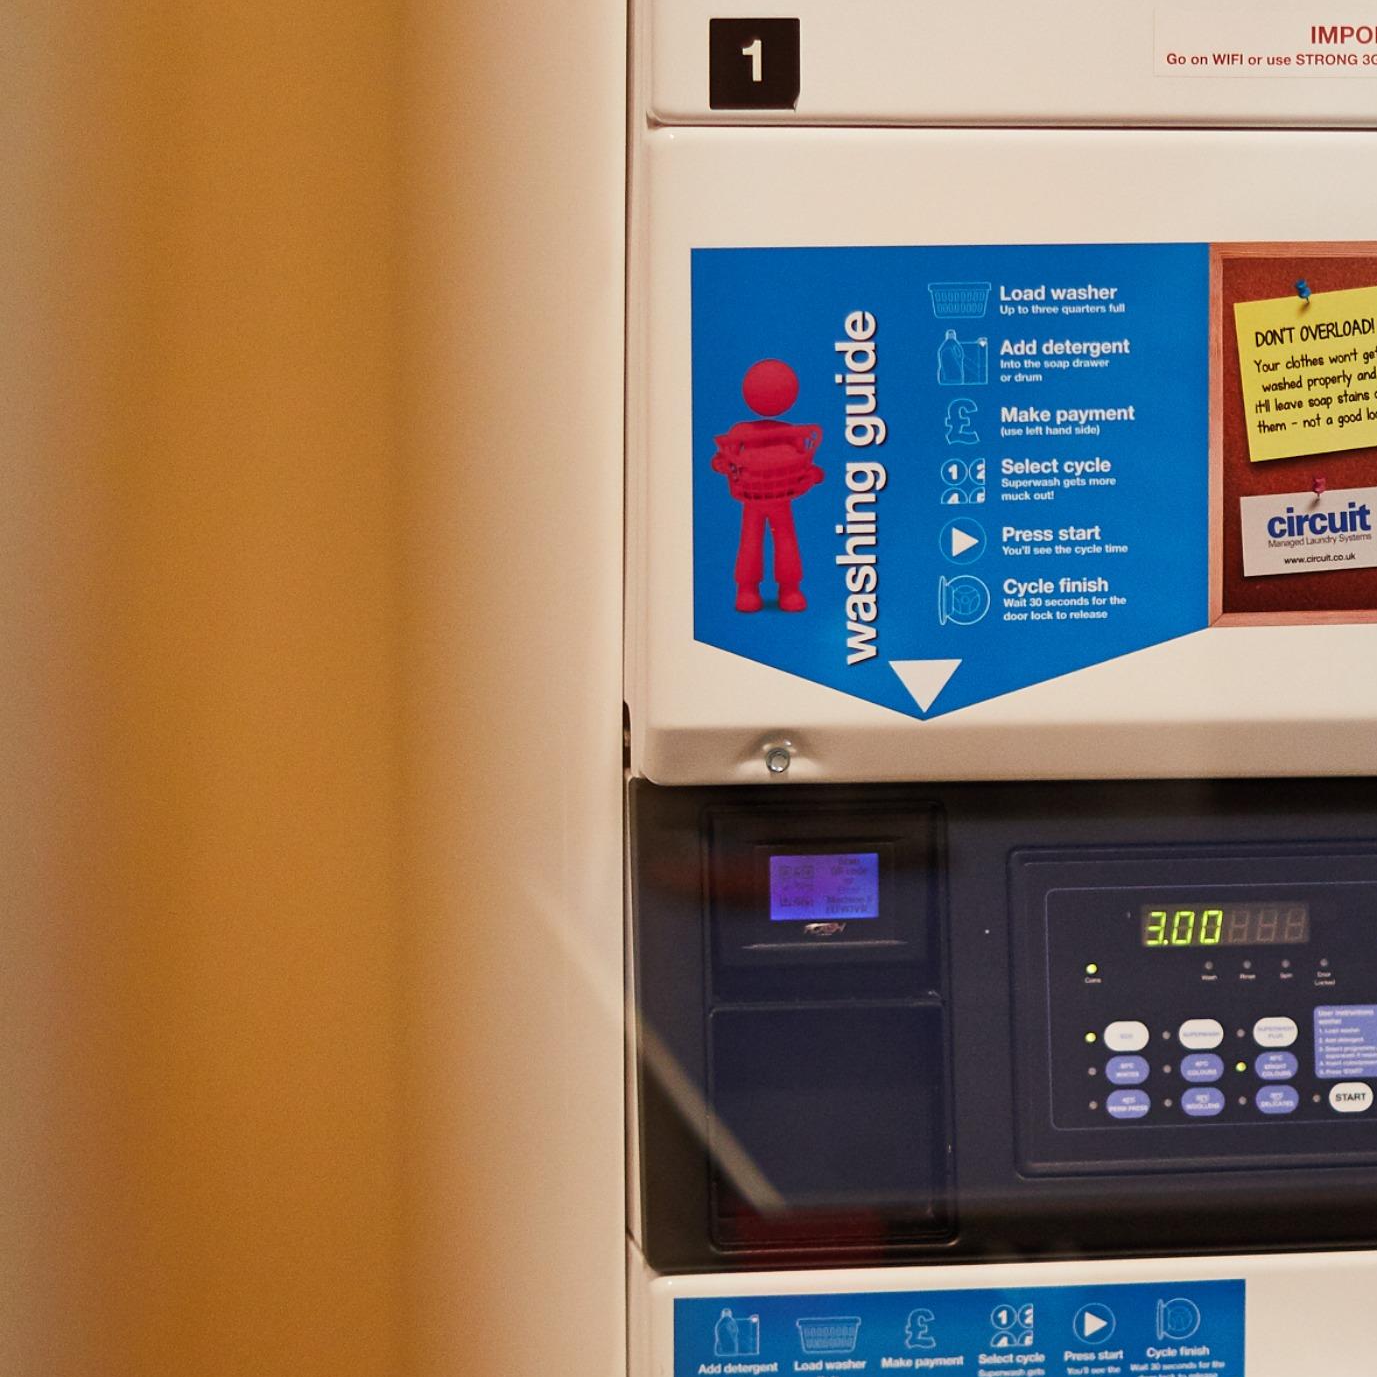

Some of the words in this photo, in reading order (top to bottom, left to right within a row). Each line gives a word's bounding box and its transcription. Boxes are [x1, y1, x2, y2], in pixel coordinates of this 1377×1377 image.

[742, 39, 763, 82] 1
[1166, 52, 1186, 65] Go
[1190, 56, 1208, 65] on
[1212, 53, 1243, 65] WIFI
[1247, 56, 1263, 65] or
[1266, 56, 1291, 66] use
[1295, 53, 1358, 66] STRONG
[999, 285, 1045, 301] Load
[1050, 284, 1117, 300] washer
[999, 304, 1015, 316] Up
[1017, 305, 1029, 314] to
[1031, 304, 1059, 314] three
[1061, 304, 1106, 315] quarters
[1108, 303, 1125, 313] full
[1254, 326, 1295, 348] DON'T
[1299, 317, 1375, 342] OVERLOAD!
[999, 339, 1037, 355] Add
[1041, 338, 1130, 358] detergent
[1253, 359, 1280, 373] Your
[1285, 353, 1324, 370] clothes
[1328, 347, 1358, 364] won't
[834, 309, 887, 447] guide
[1261, 376, 1303, 393] washed
[1306, 371, 1352, 391] properly
[1356, 366, 1377, 381] and
[1274, 398, 1303, 411] leave
[1307, 396, 1333, 408] soap
[1336, 390, 1370, 404] stains
[1000, 406, 1051, 423] Make
[1055, 405, 1135, 425] payment
[1256, 419, 1286, 434] them
[1302, 412, 1321, 428] not
[1325, 416, 1333, 426] a
[1337, 407, 1362, 427] good
[1001, 458, 1058, 474] Select
[1063, 456, 1111, 476] cycle
[1267, 502, 1371, 539] circuit
[1002, 526, 1053, 542] Press
[1058, 525, 1101, 541] start
[1267, 537, 1304, 549] Managed
[1305, 534, 1337, 545] Laundry
[1338, 533, 1372, 543] Systems
[835, 460, 888, 665] washing
[1283, 552, 1355, 564] www.circuit.co.uk
[1003, 578, 1054, 598] Cycle
[1058, 577, 1108, 593] finish
[1146, 909, 1224, 946] 3.00
[1335, 1092, 1367, 1103] START
[880, 1357, 913, 1368] Make
[914, 1355, 964, 1369] payment
[978, 1353, 1014, 1365] Select
[1014, 1352, 1045, 1365] cycle
[1063, 1350, 1096, 1361] Press
[1097, 1349, 1123, 1360] start
[1146, 1347, 1177, 1359] Cycle
[1178, 1345, 1210, 1356] finish
[698, 1363, 722, 1374] Add
[723, 1362, 778, 1375] detergent
[793, 1360, 823, 1371] Load
[824, 1359, 866, 1370] washer
